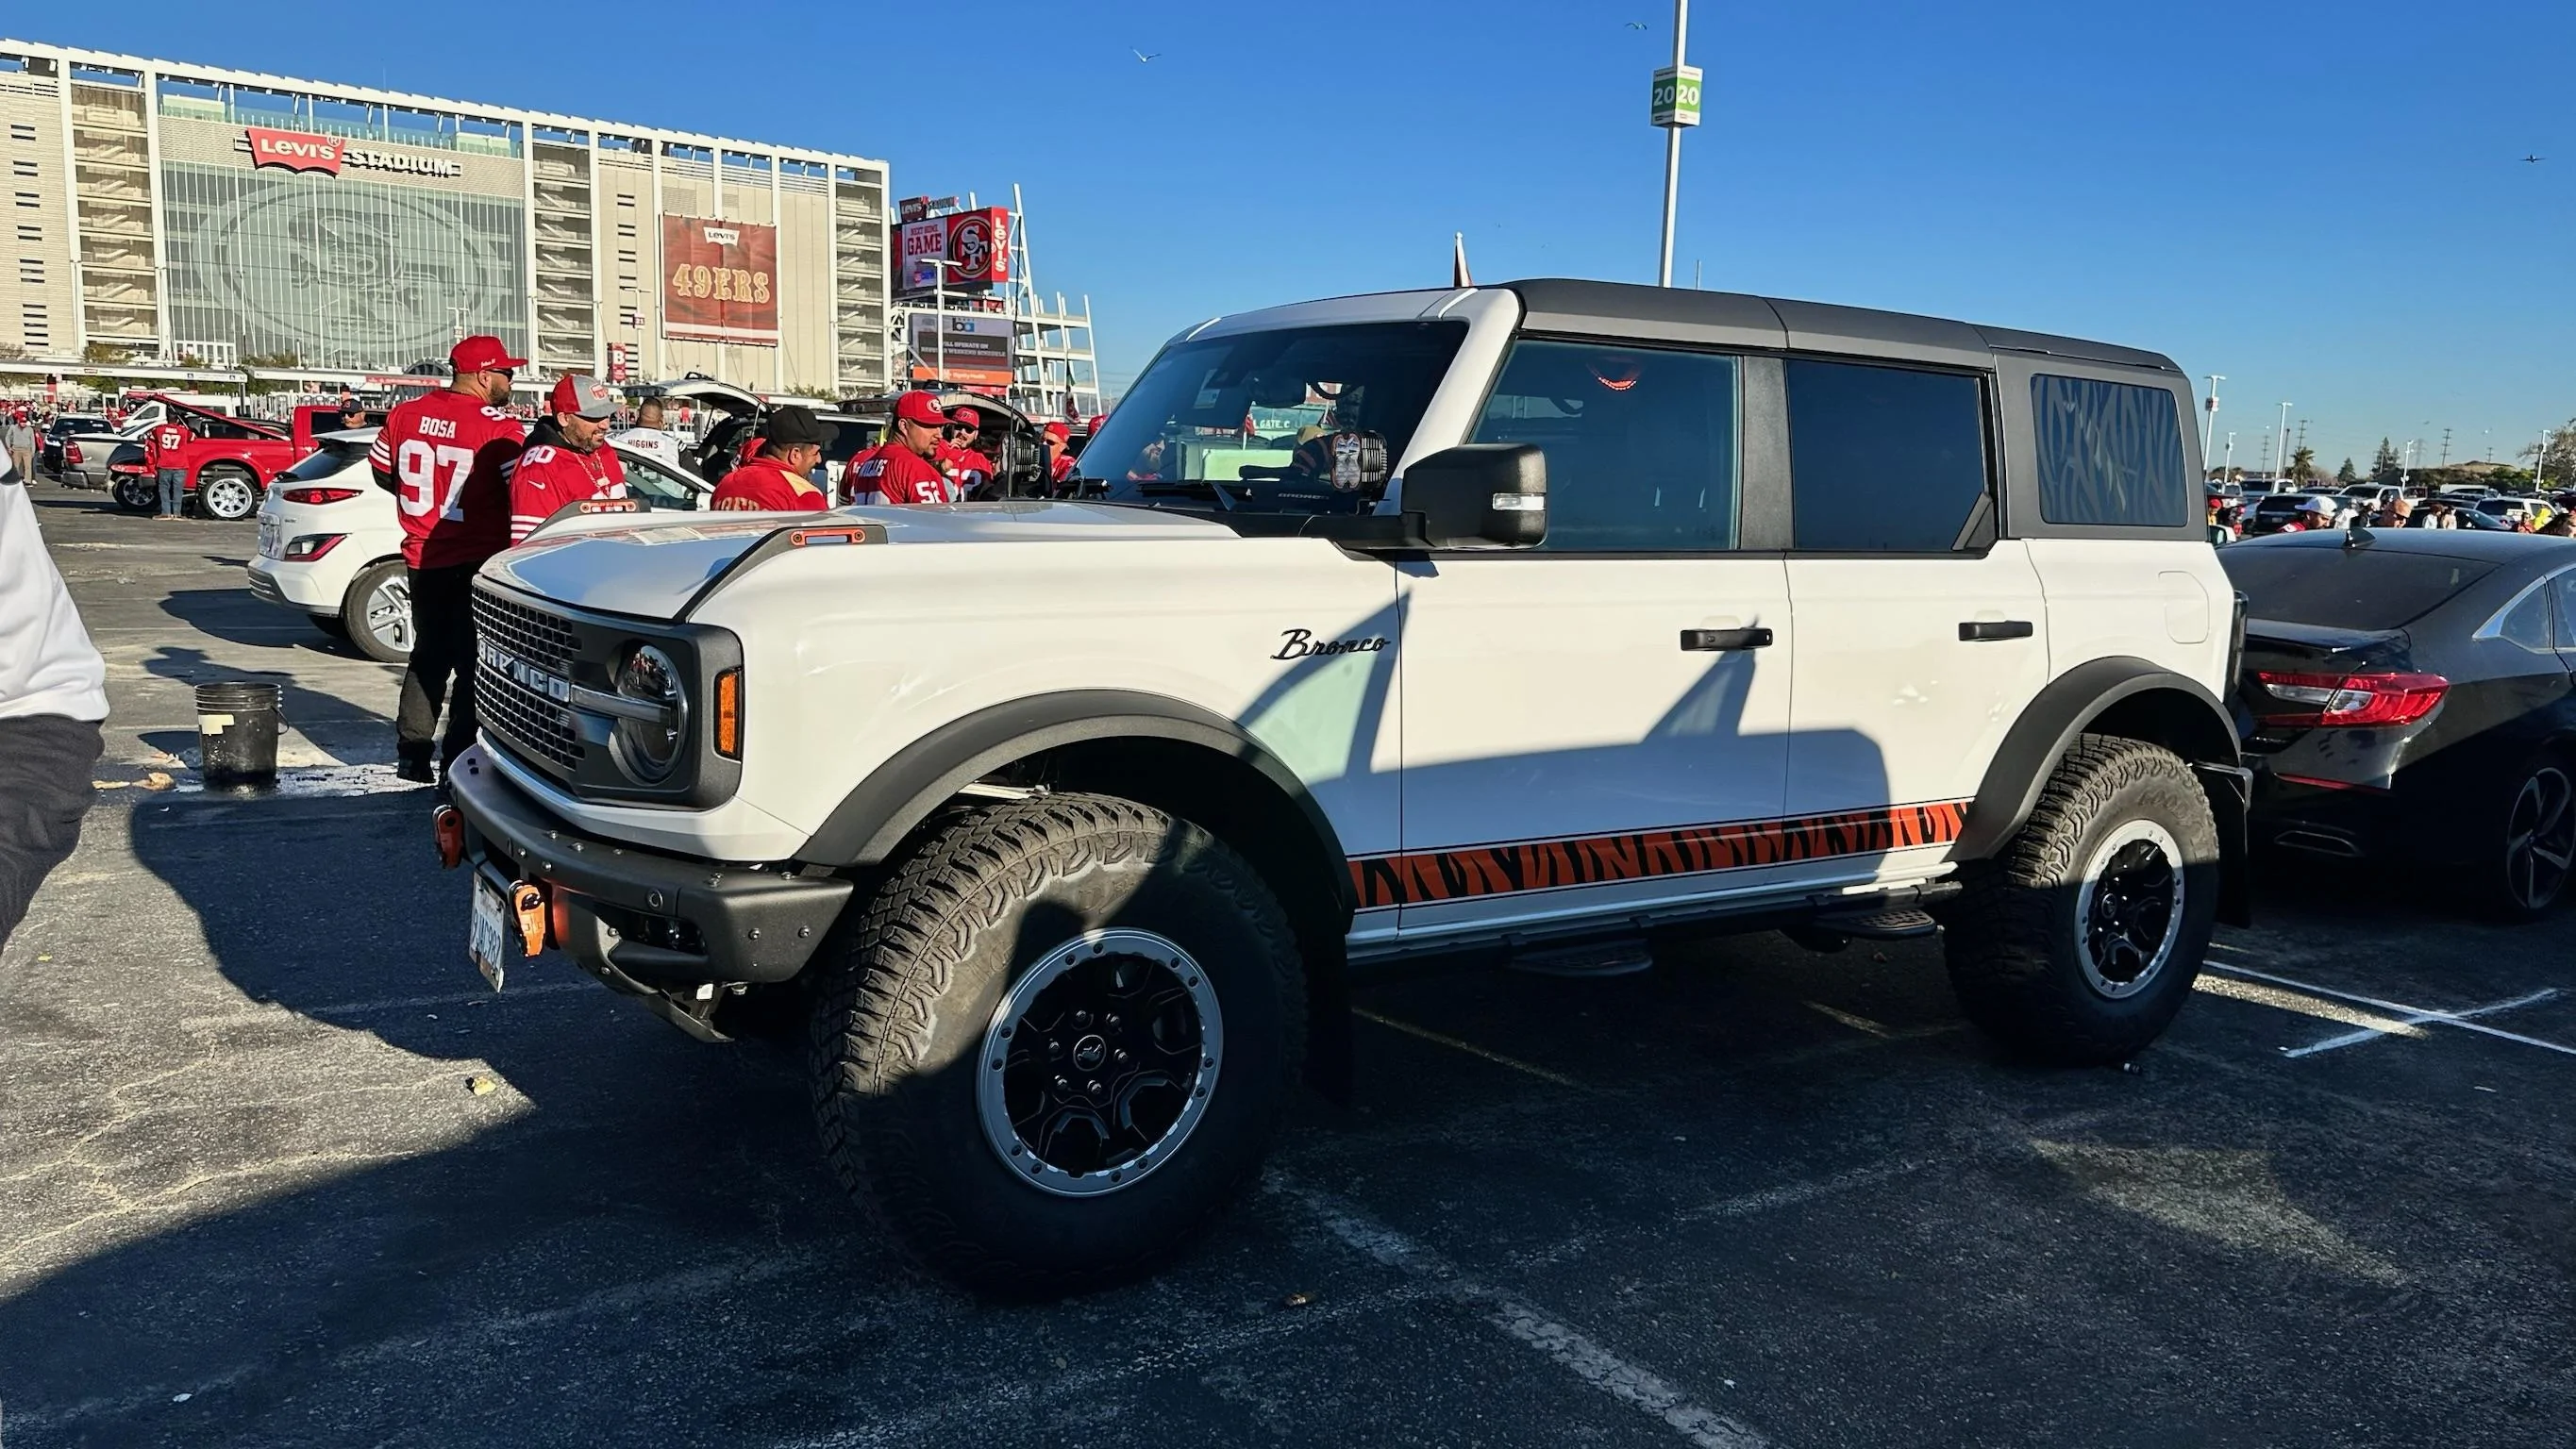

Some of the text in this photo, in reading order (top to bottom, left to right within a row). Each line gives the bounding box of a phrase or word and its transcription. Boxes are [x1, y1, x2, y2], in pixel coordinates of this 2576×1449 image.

[1653, 86, 1675, 106] 20
[1678, 84, 1698, 106] 20
[350, 148, 453, 175] STADIUM
[908, 233, 942, 256] GAME
[673, 263, 770, 304] 49ERS
[612, 350, 625, 365] B
[418, 416, 457, 439] BOSA
[161, 433, 181, 450] 97
[627, 439, 659, 450] HIGGINS
[522, 445, 557, 467] 80
[398, 439, 475, 523] 97
[1270, 628, 1392, 659] Bronco
